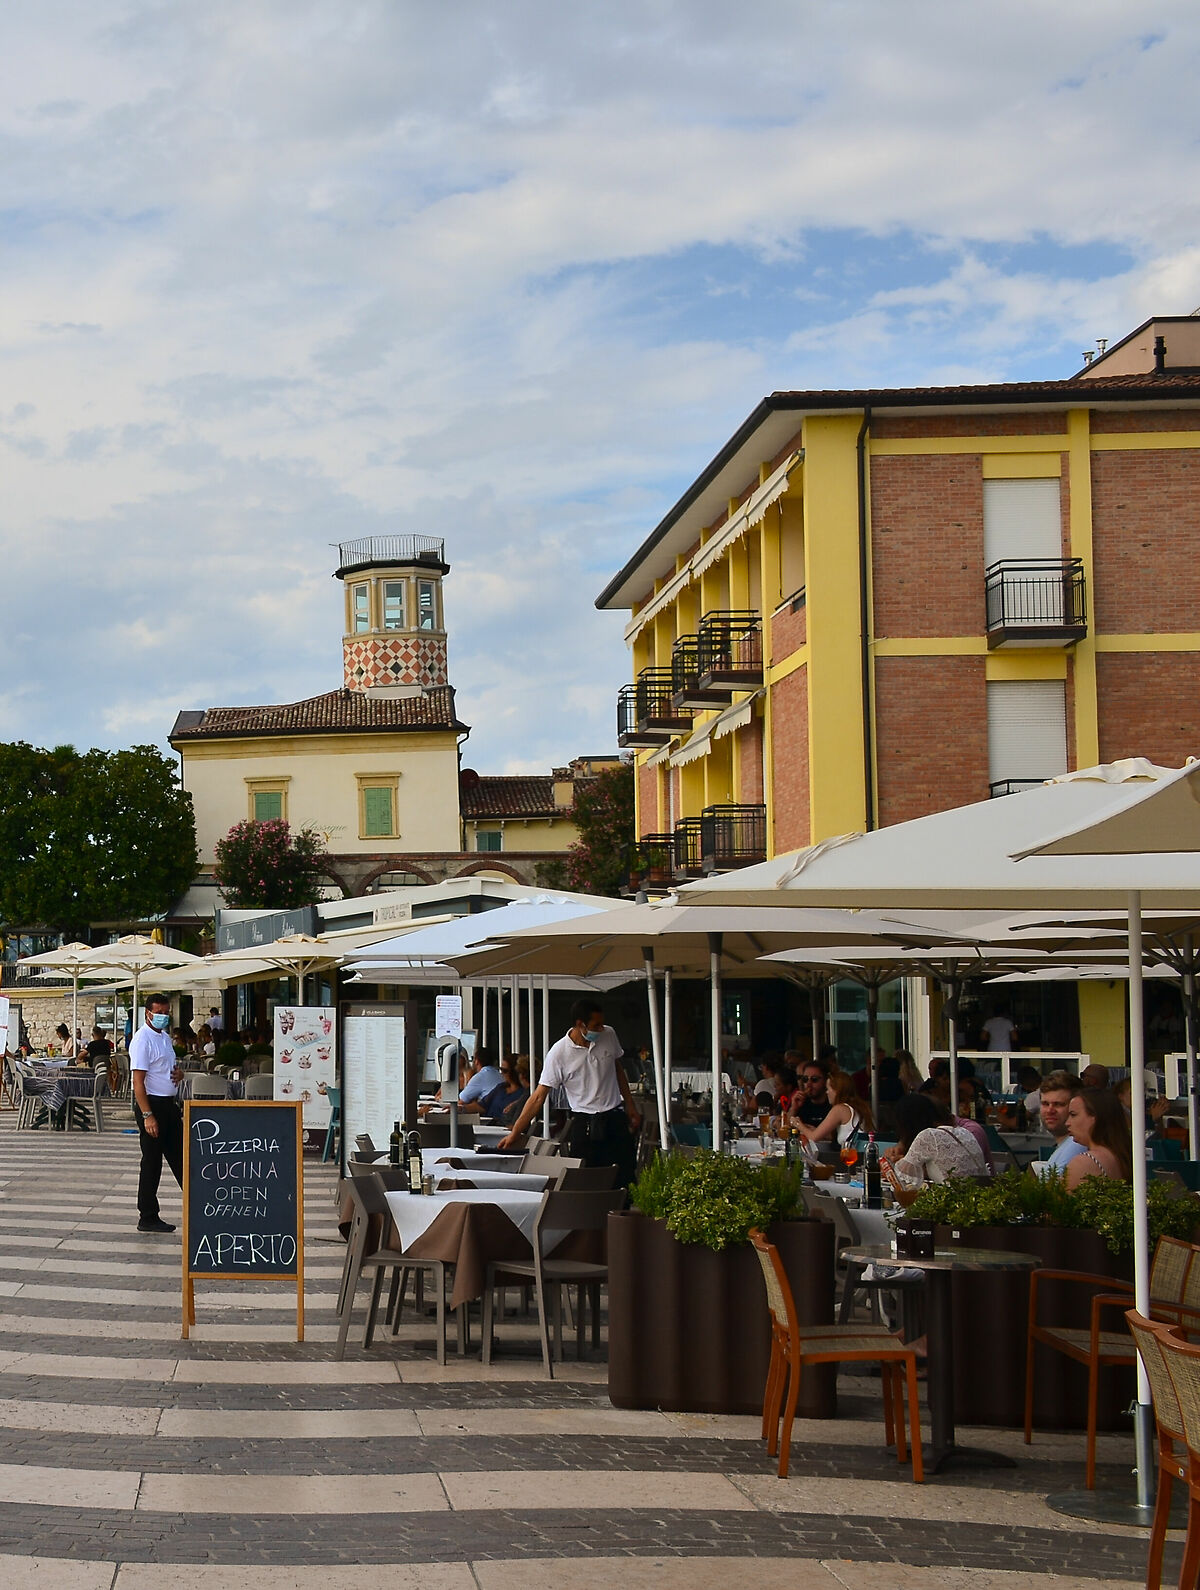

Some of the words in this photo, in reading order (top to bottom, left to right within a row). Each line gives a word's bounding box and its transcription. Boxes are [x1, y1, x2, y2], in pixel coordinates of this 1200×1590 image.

[191, 1118, 280, 1155] PIZZERIA
[200, 1161, 279, 1180] CUCINA
[214, 1186, 268, 1200] OPEN
[192, 1232, 297, 1267] APERTO
